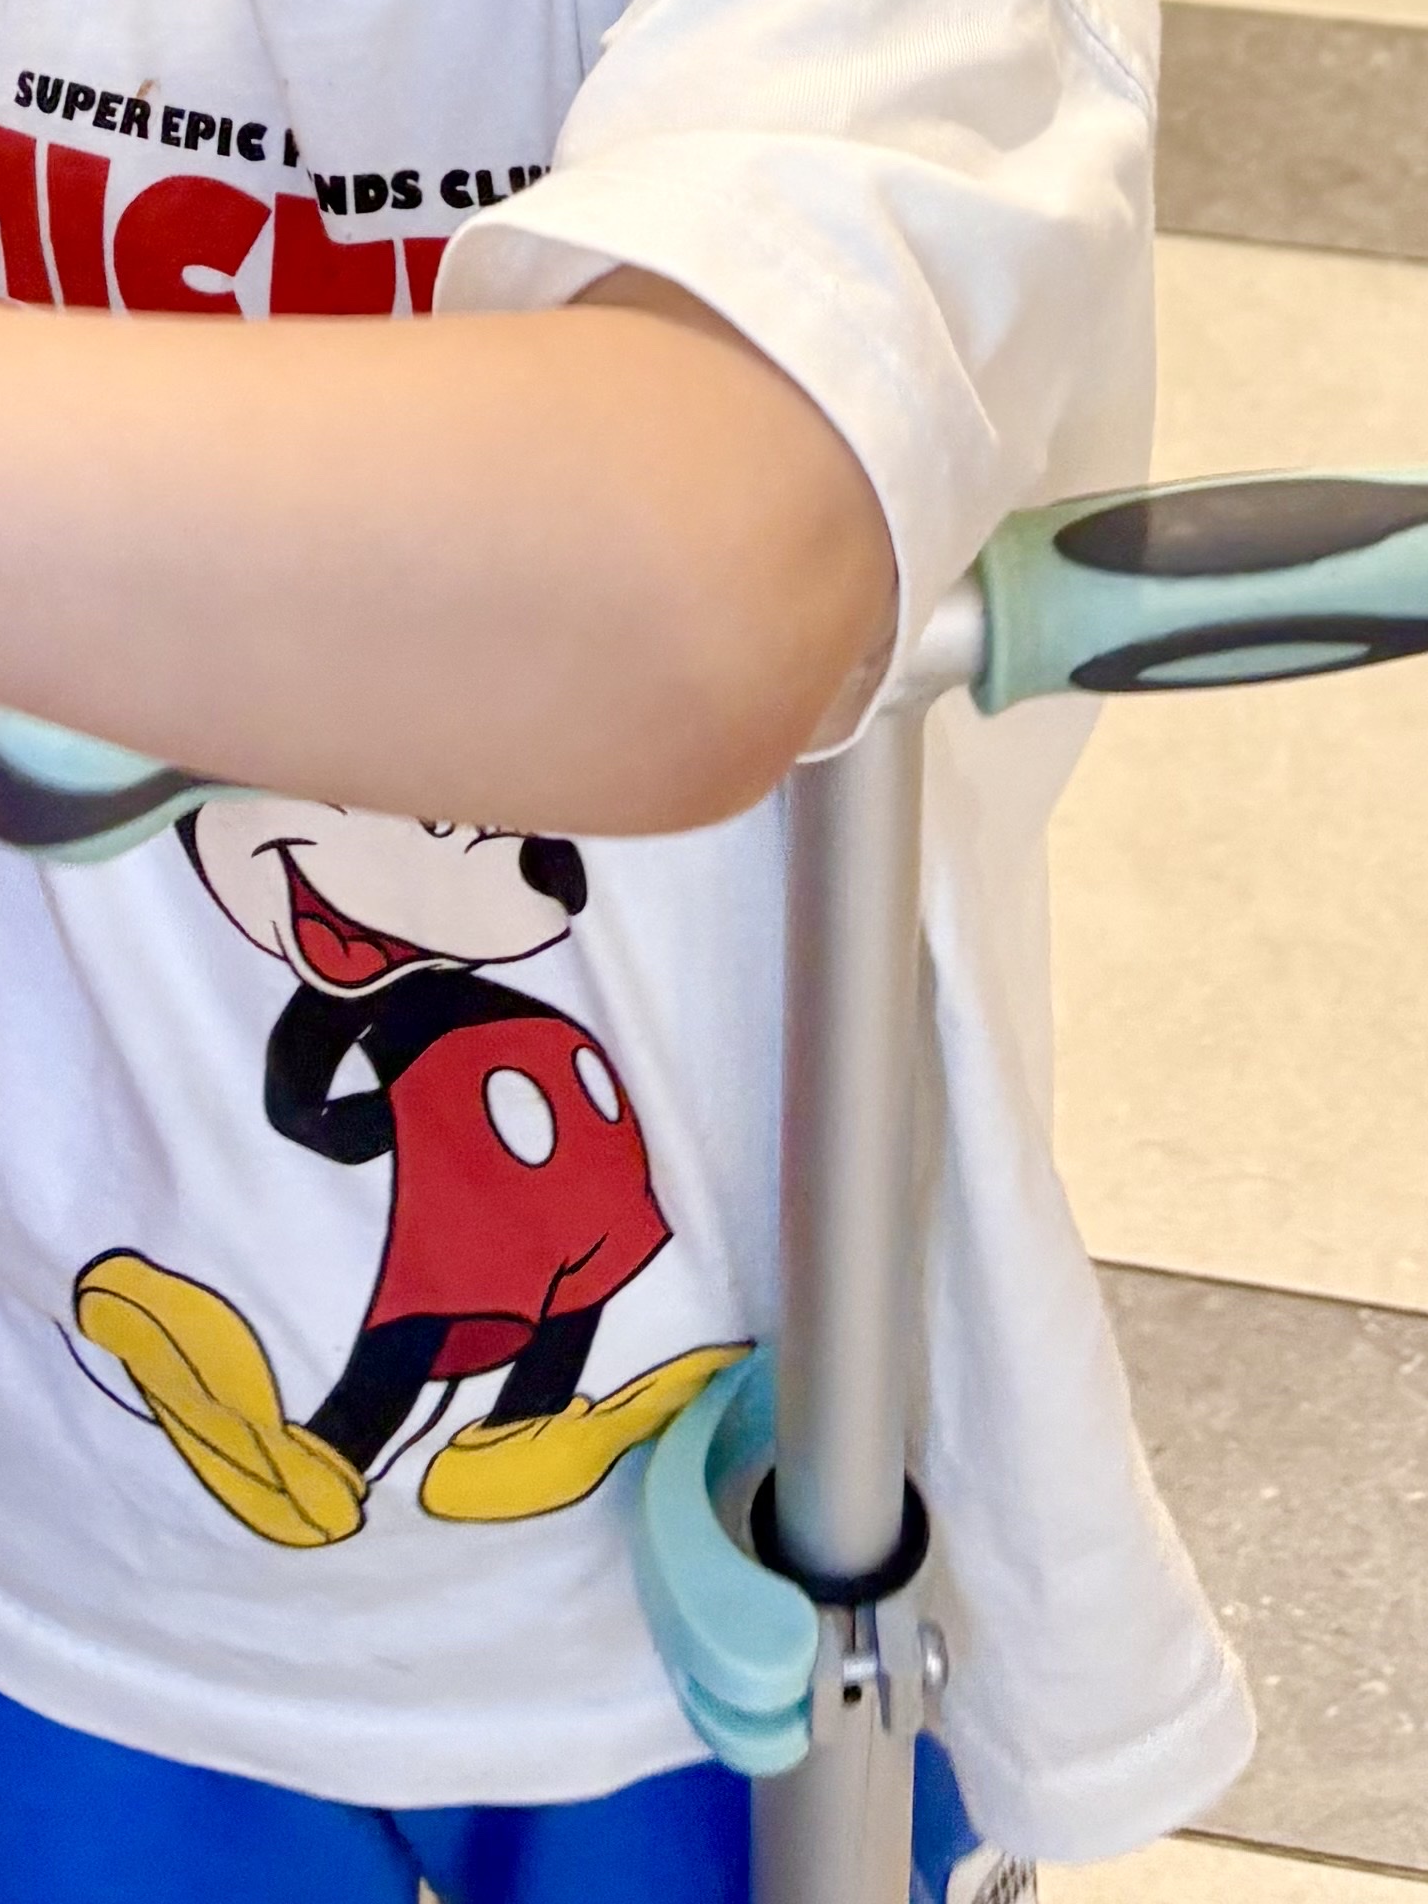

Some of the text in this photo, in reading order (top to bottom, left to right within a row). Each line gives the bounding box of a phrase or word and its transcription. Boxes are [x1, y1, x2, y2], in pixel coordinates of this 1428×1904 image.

[14, 70, 151, 140] SUPER
[161, 104, 268, 162] EPIC
[440, 164, 552, 209] CLU
